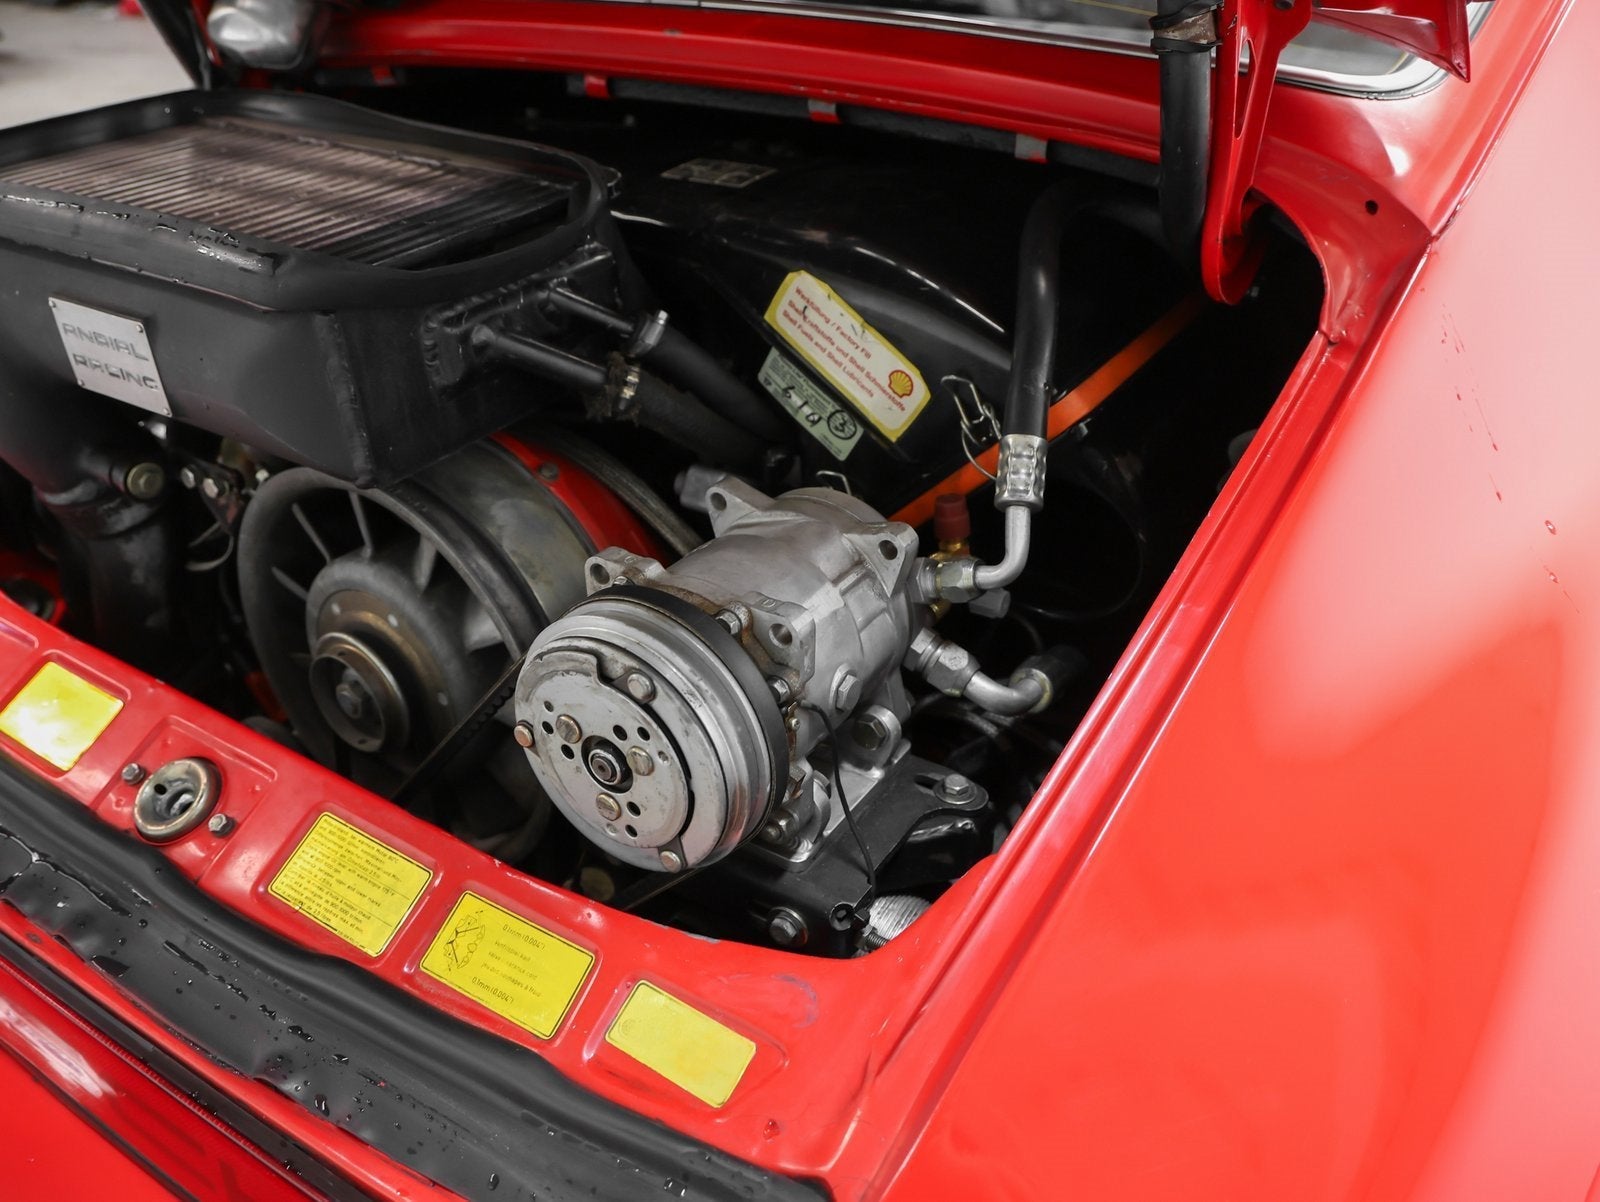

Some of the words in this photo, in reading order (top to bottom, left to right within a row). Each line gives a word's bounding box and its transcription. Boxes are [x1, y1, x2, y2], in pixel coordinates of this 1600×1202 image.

[783, 310, 796, 325] Shell
[798, 324, 813, 340] Fuels
[815, 340, 826, 352] and
[827, 351, 842, 367] Shell
[842, 366, 873, 397] Lubricants
[836, 325, 859, 349] Factory
[861, 347, 870, 358] Fill
[836, 344, 848, 358] und
[849, 356, 864, 372] Shell
[865, 371, 905, 411] Schmierstoffe
